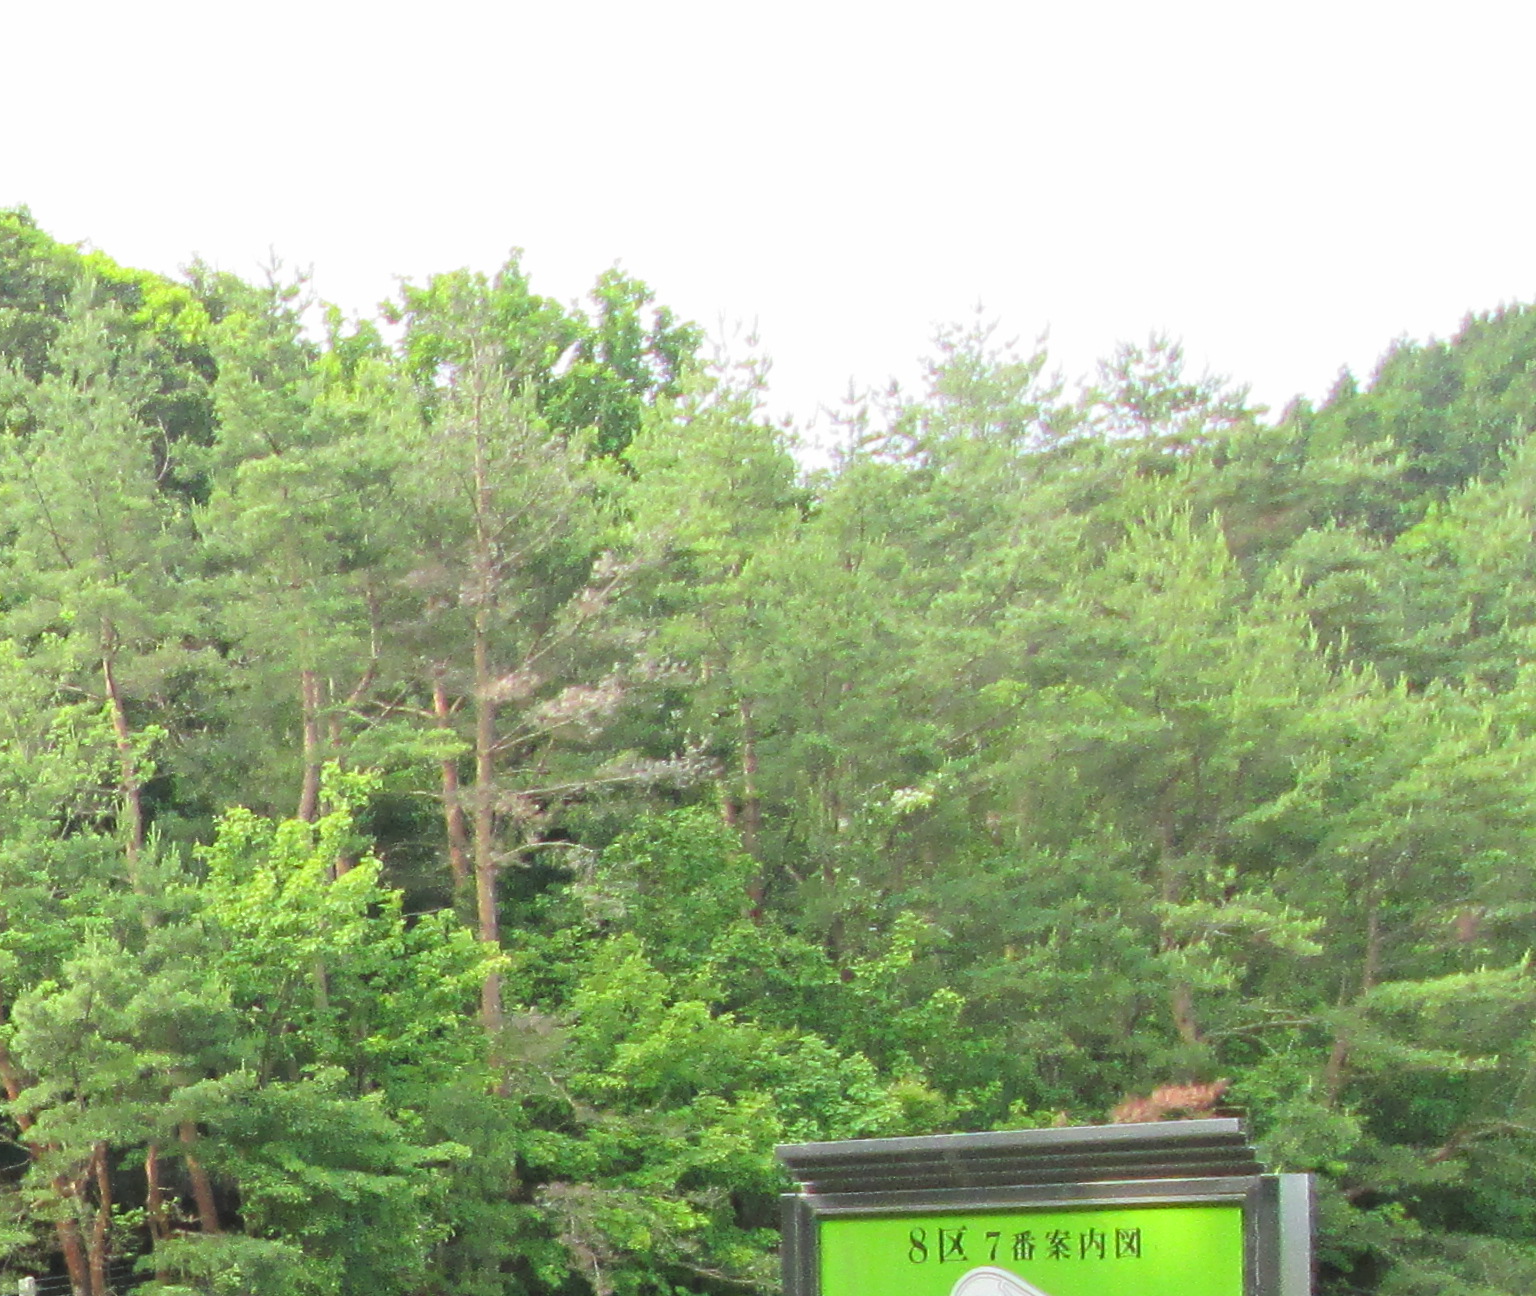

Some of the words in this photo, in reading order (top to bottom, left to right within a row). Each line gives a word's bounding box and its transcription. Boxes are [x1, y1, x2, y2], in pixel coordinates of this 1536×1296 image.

[908, 1226, 1142, 1264] 8区7番案内図
